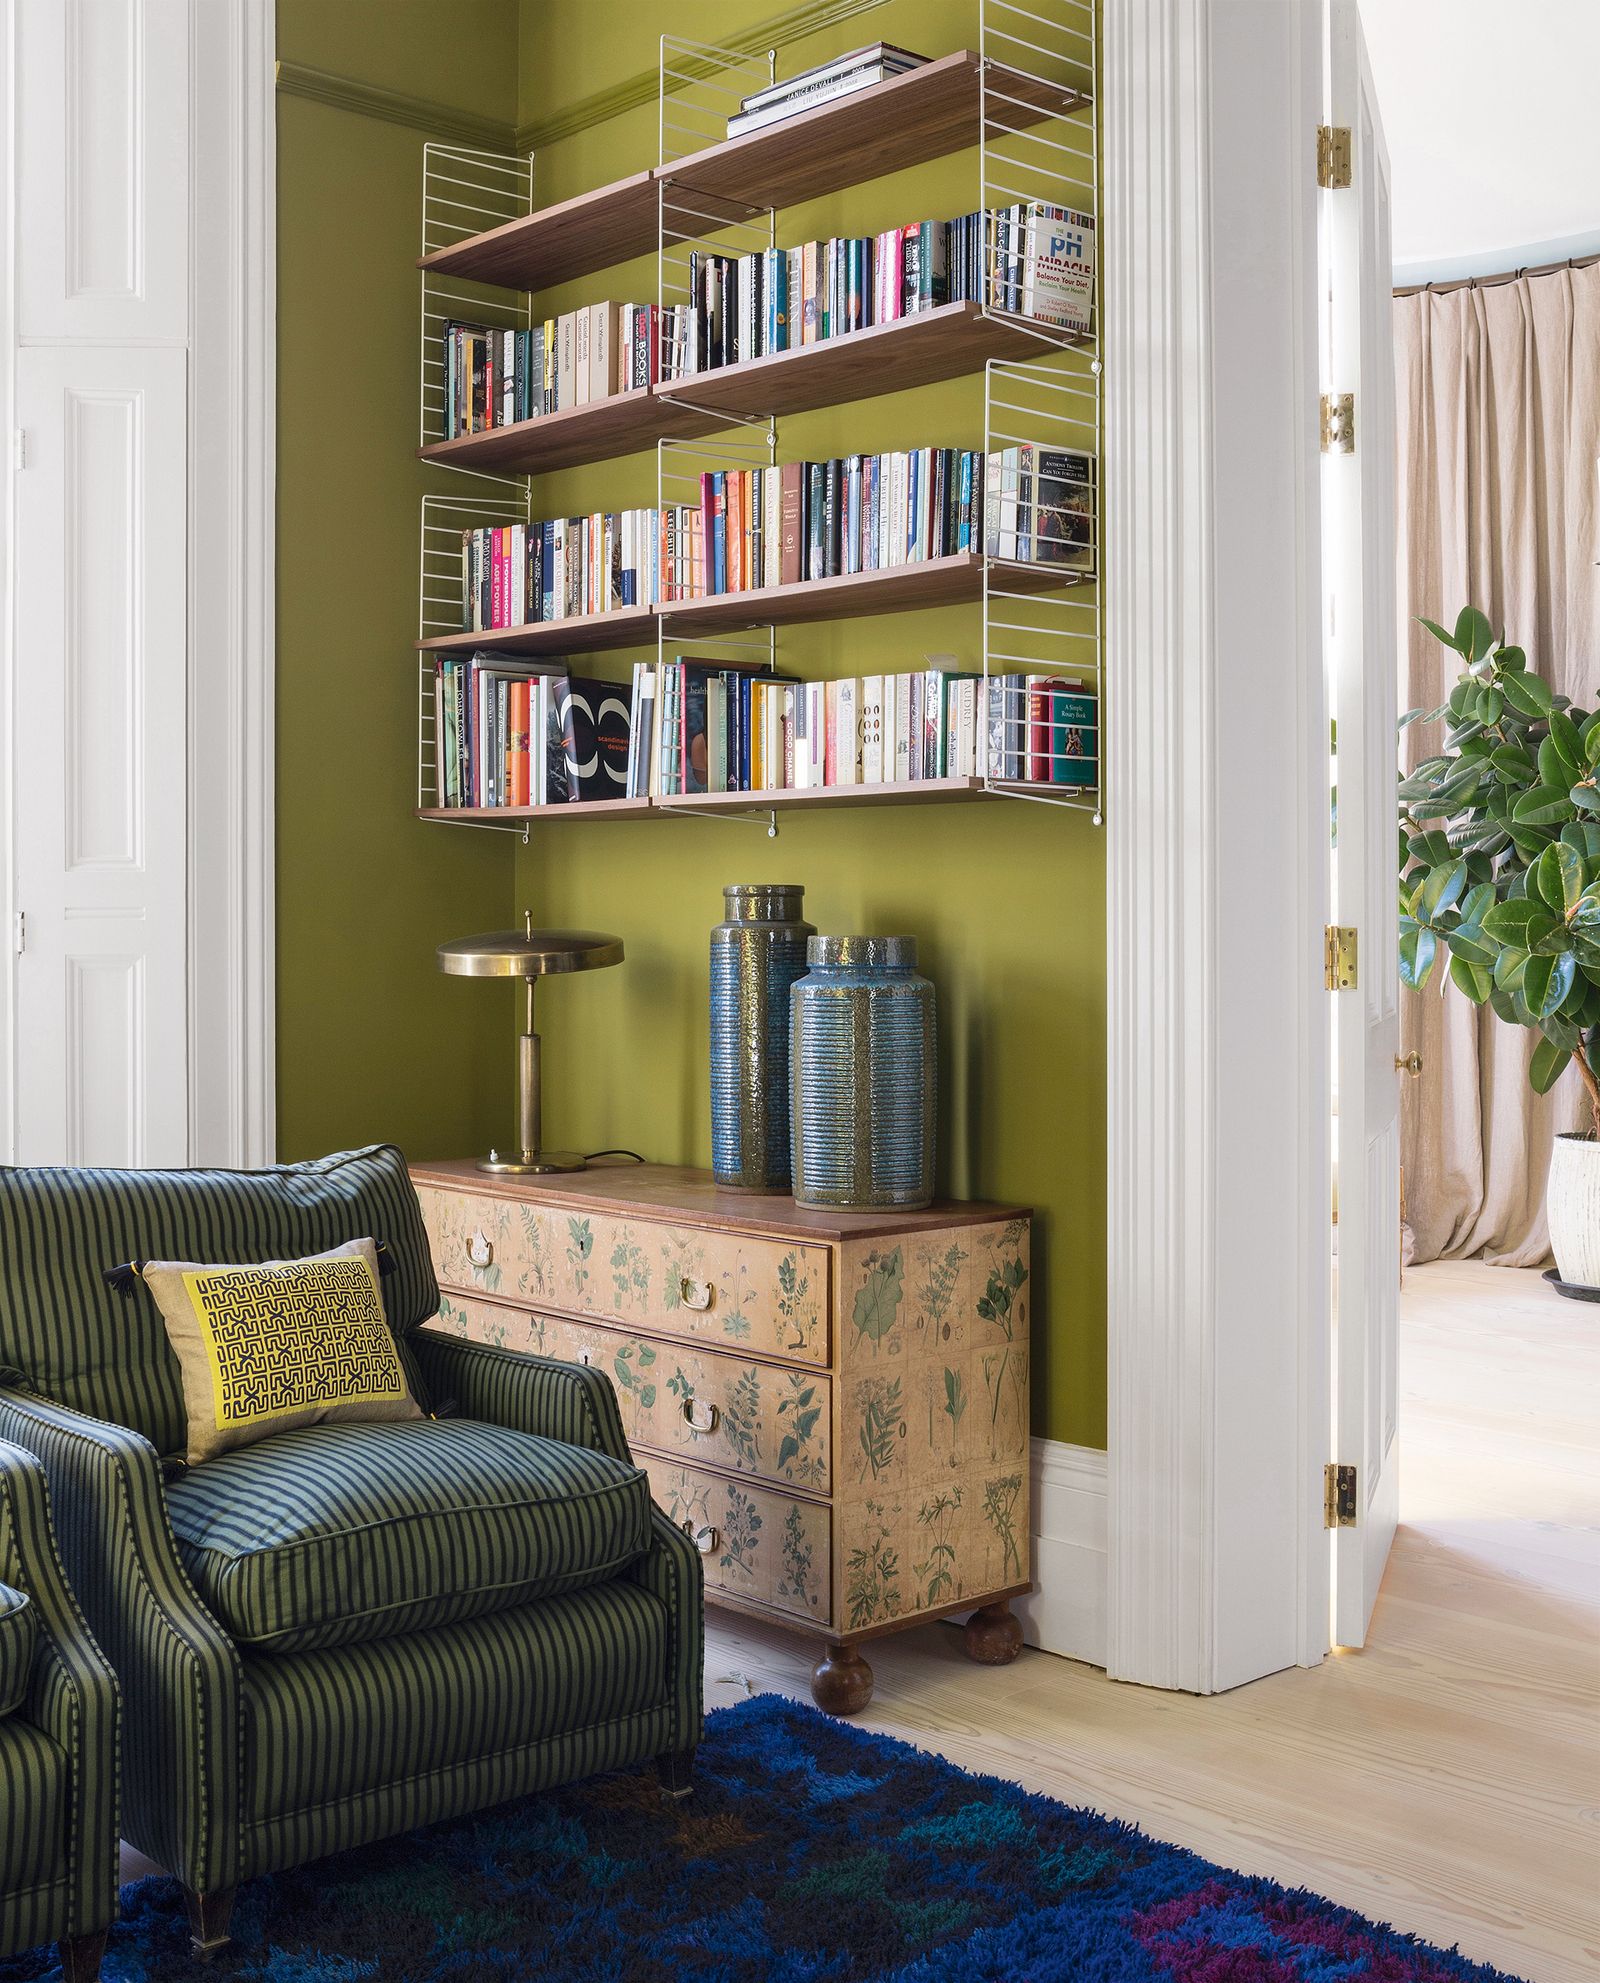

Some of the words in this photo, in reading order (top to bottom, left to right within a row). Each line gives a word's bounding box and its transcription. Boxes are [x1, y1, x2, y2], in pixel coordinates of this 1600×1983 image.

[997, 239, 1005, 269] Colho
[1036, 272, 1060, 283] Balance
[1061, 276, 1075, 287] Your
[1075, 280, 1089, 289] Diet,
[1039, 281, 1058, 290] Reclaim
[1058, 284, 1071, 292] Your
[1070, 286, 1086, 295] Health
[639, 341, 647, 386] BOOKS
[963, 682, 972, 728] AUDREY
[1061, 711, 1075, 719] Rosary
